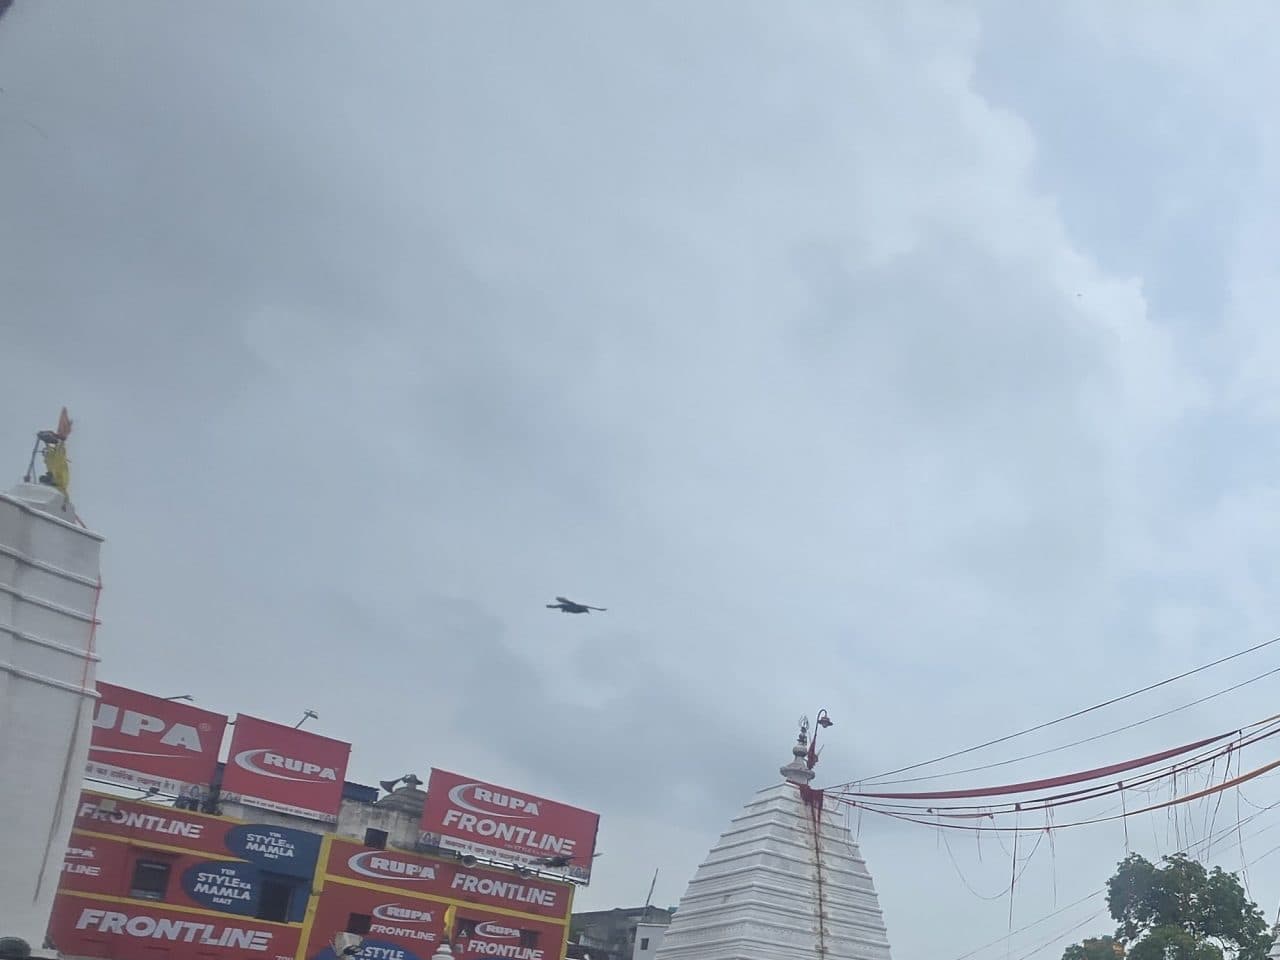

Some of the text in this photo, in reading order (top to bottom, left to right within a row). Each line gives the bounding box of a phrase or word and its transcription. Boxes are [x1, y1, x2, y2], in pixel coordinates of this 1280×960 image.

[91, 703, 203, 753] UPA
[263, 752, 337, 781] RUPA
[473, 786, 540, 816] RUPA
[246, 833, 286, 848] STYLE
[441, 809, 577, 856] FRONTLINE
[245, 841, 295, 858] MAMLA
[196, 871, 242, 888] STYLE
[370, 856, 558, 908] RUPA FRONTLINE
[193, 882, 252, 901] MAMLA
[385, 905, 432, 922] RUPA
[75, 907, 274, 951] FRONTLINE
[369, 923, 437, 941] FRONTLINE
[485, 923, 521, 938] RUPA
